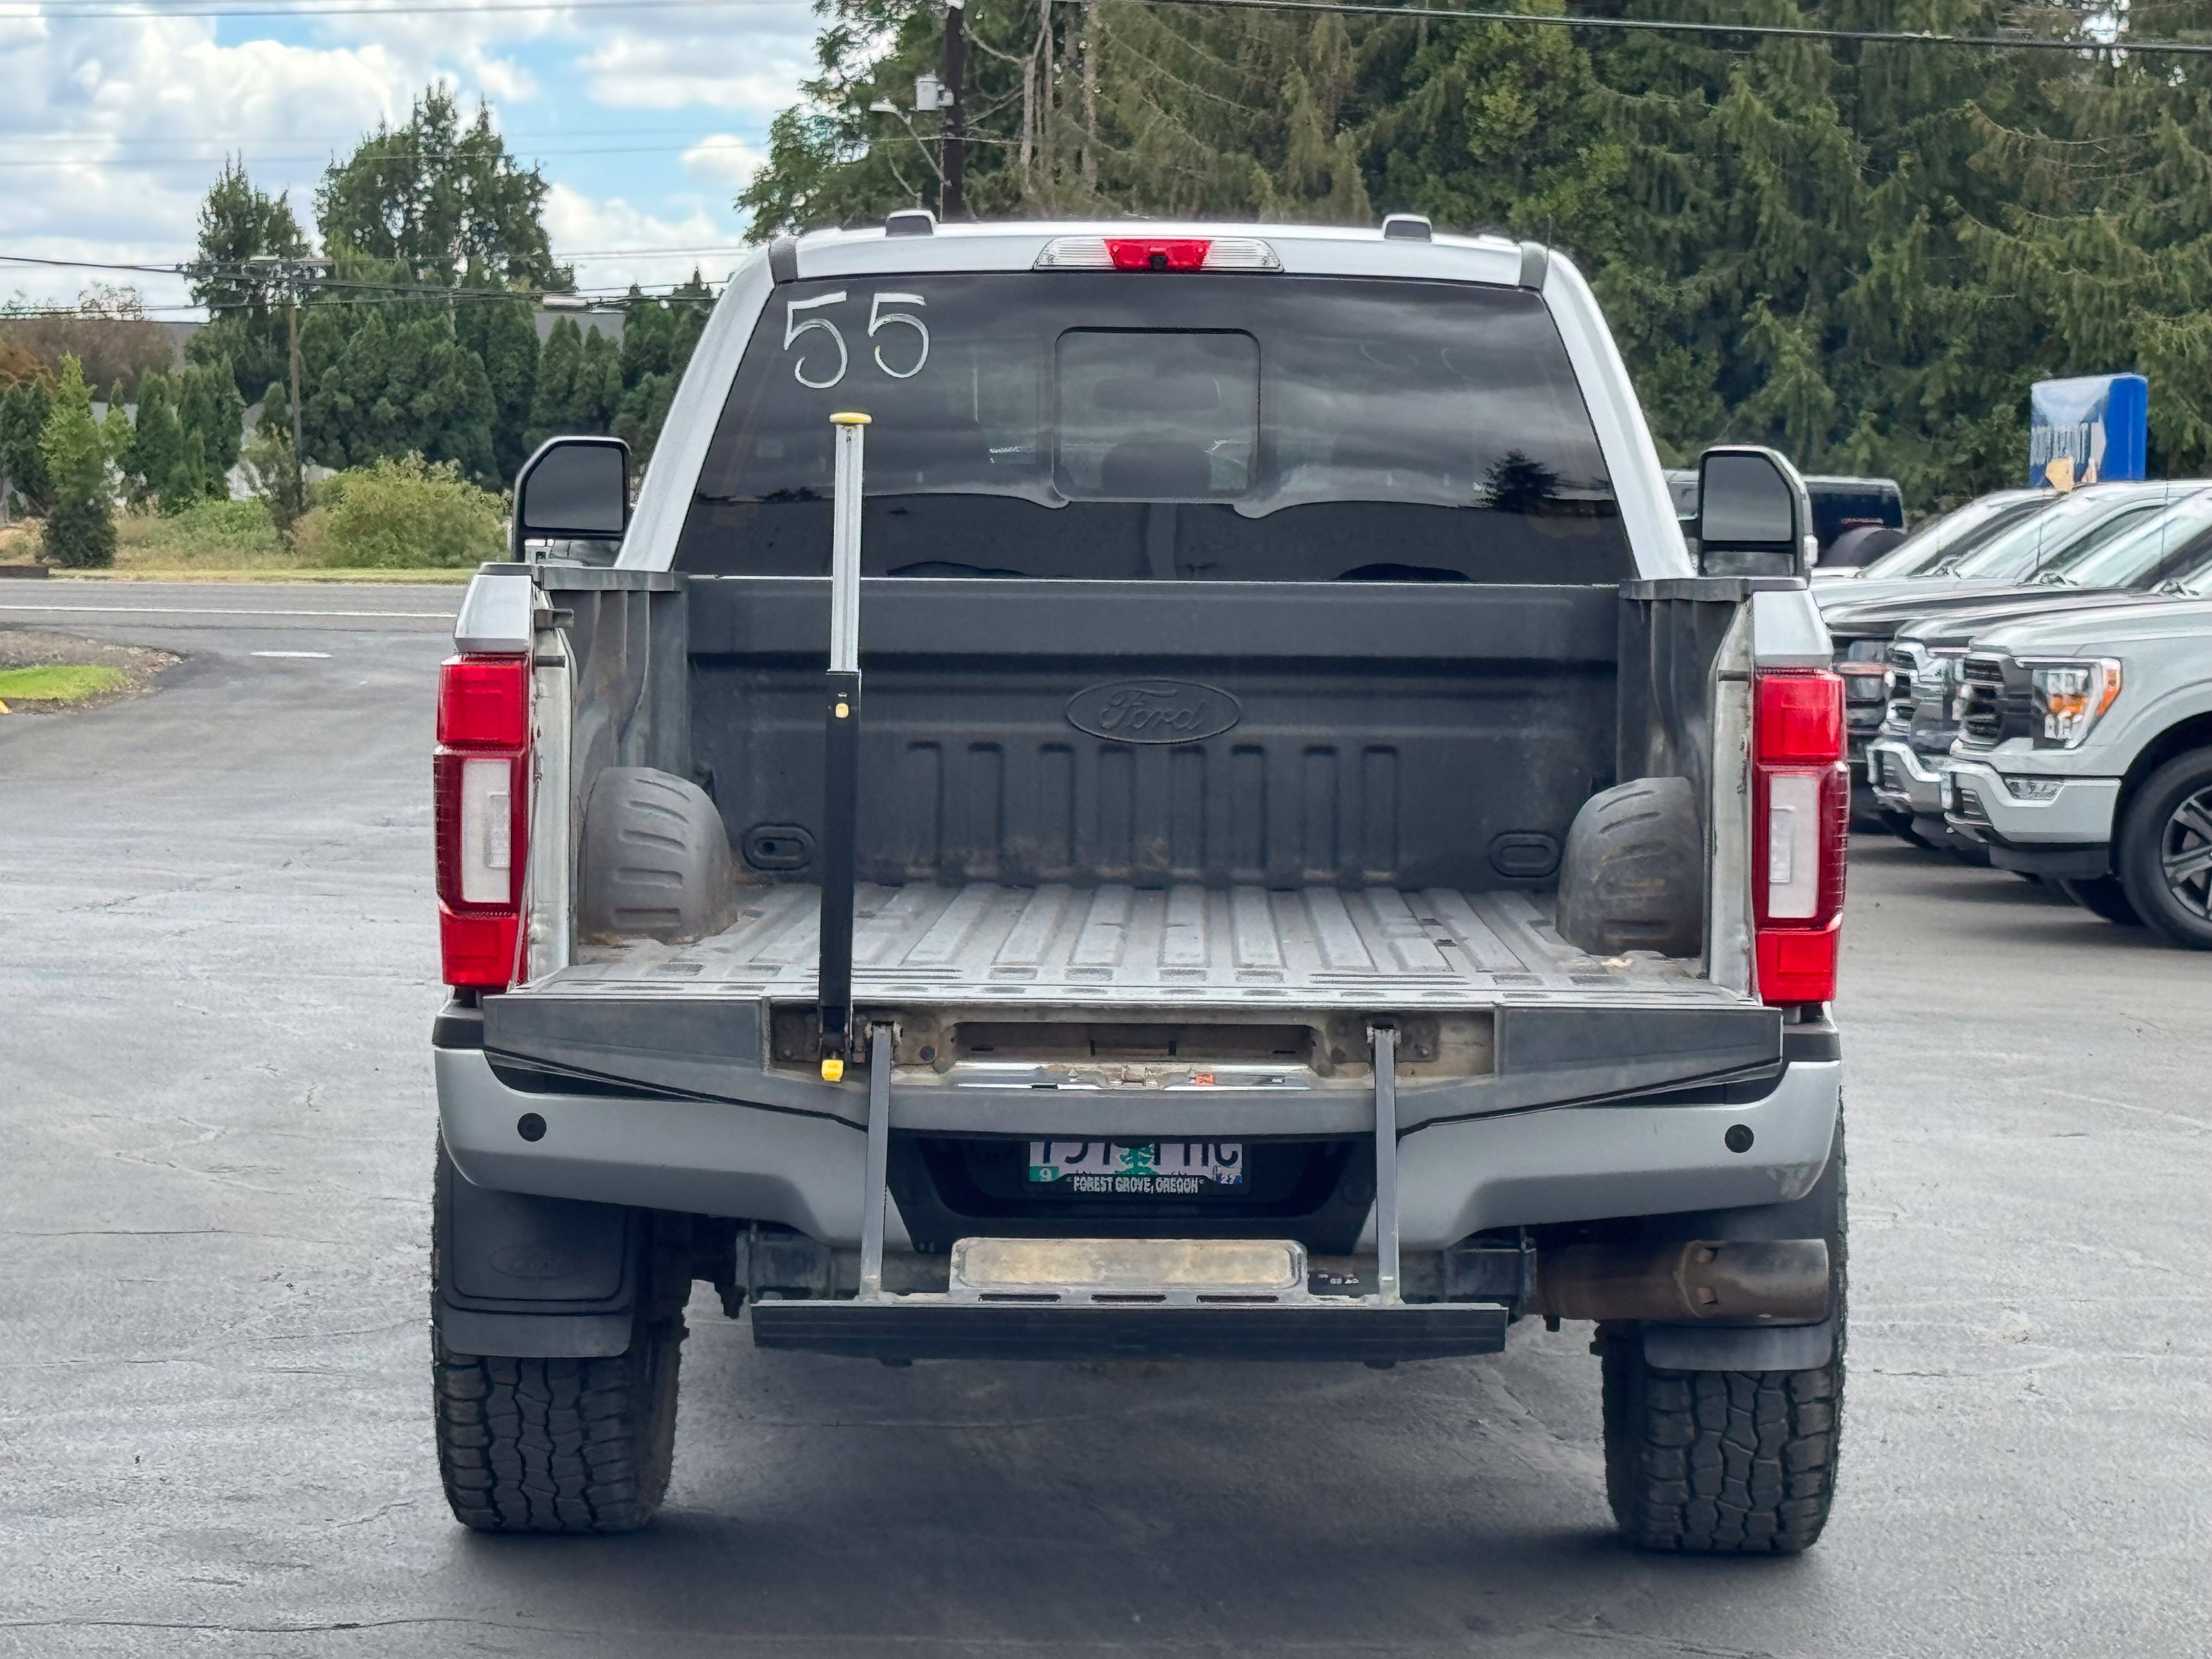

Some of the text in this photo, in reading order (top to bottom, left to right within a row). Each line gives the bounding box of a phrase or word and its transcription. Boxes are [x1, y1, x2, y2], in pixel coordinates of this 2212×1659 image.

[785, 291, 929, 388] 55
[1101, 688, 1205, 730] Ford
[1074, 1176, 1113, 1193] FOREST
[1155, 1177, 1198, 1193] OREGON
